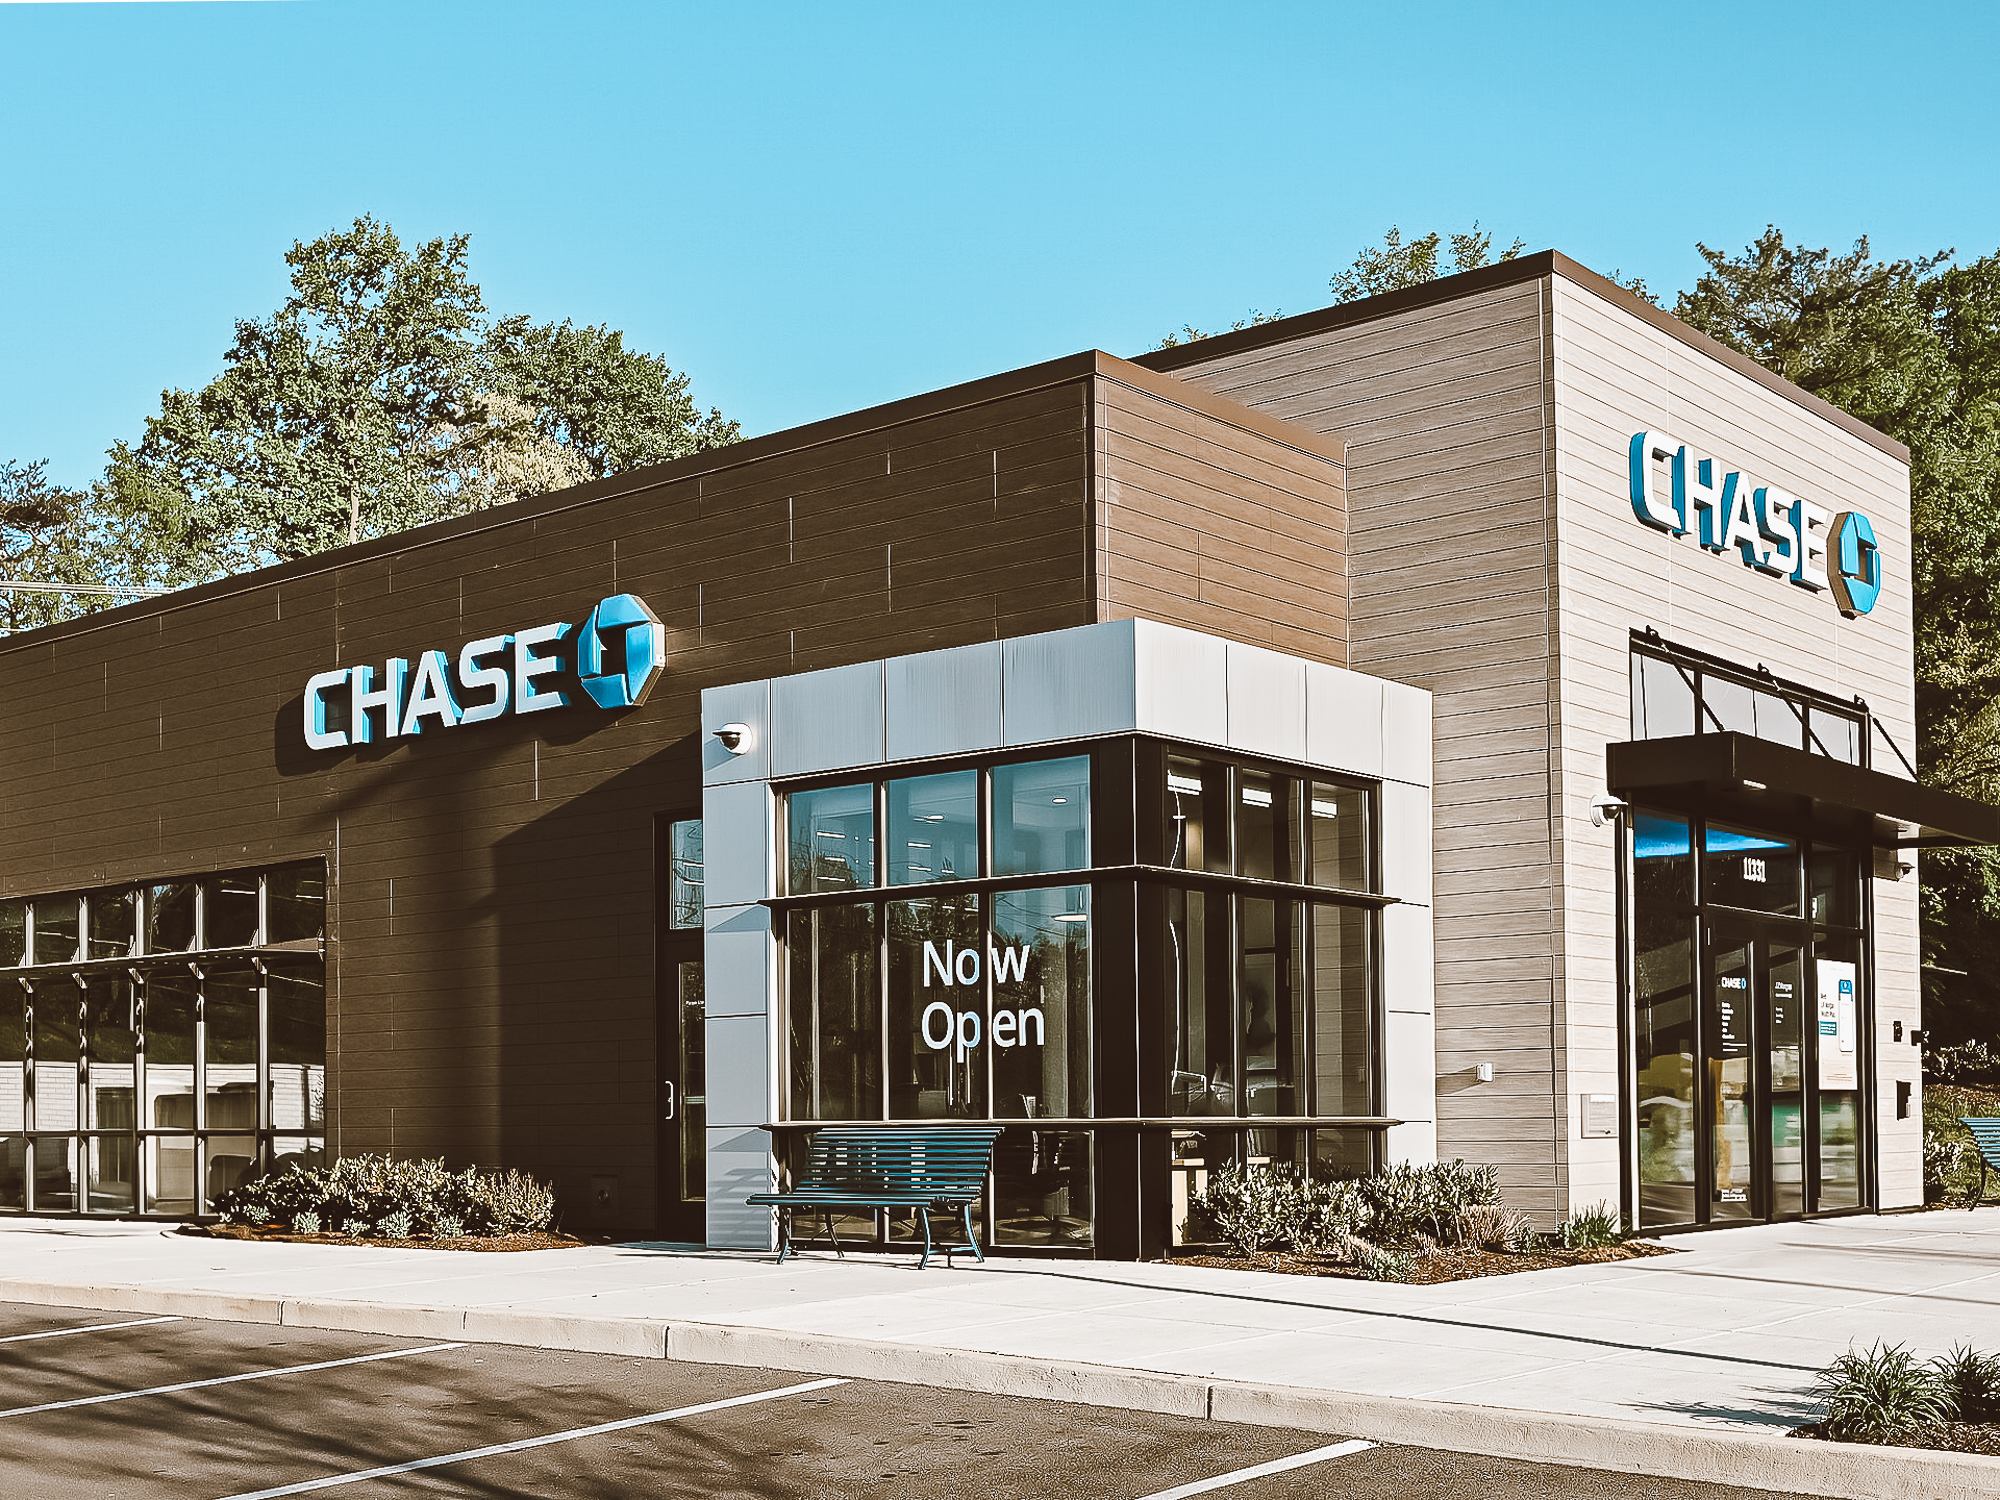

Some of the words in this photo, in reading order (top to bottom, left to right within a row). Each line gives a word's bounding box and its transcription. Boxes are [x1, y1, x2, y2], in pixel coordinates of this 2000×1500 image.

[1630, 430, 1829, 593] CHASE
[304, 622, 572, 750] CHASE
[923, 939, 1031, 987] Now
[1721, 976, 1741, 990] CHASE
[921, 1001, 1045, 1063] Open
